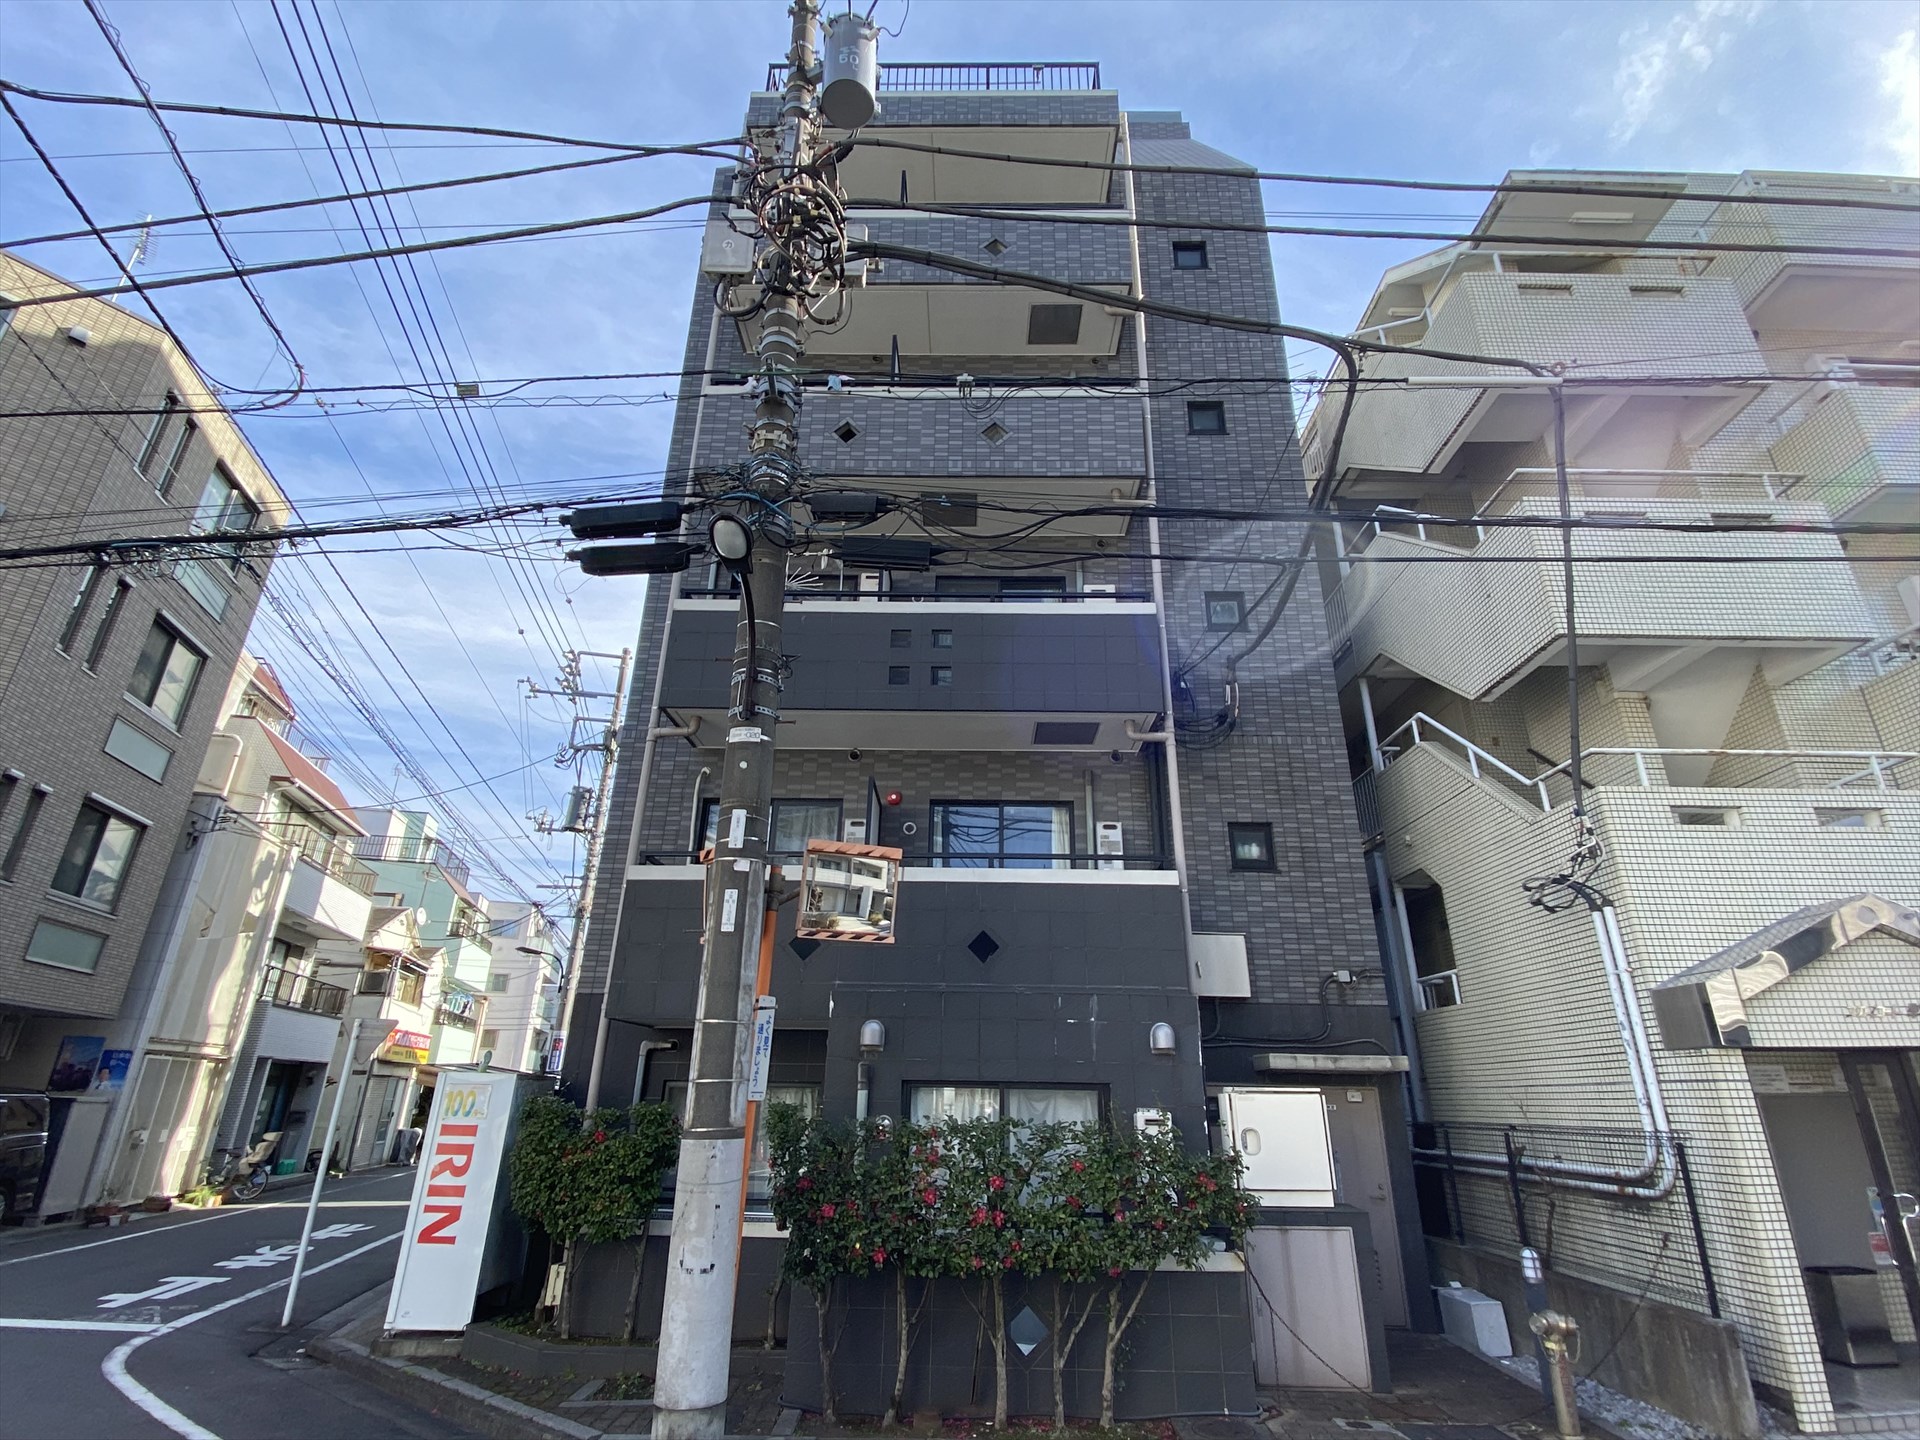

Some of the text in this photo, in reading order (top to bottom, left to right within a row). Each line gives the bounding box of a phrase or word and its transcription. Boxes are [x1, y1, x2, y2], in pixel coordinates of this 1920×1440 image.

[763, 1014, 772, 1058] よく見て
[444, 1089, 477, 1117] 100
[417, 1124, 479, 1245] IRIN
